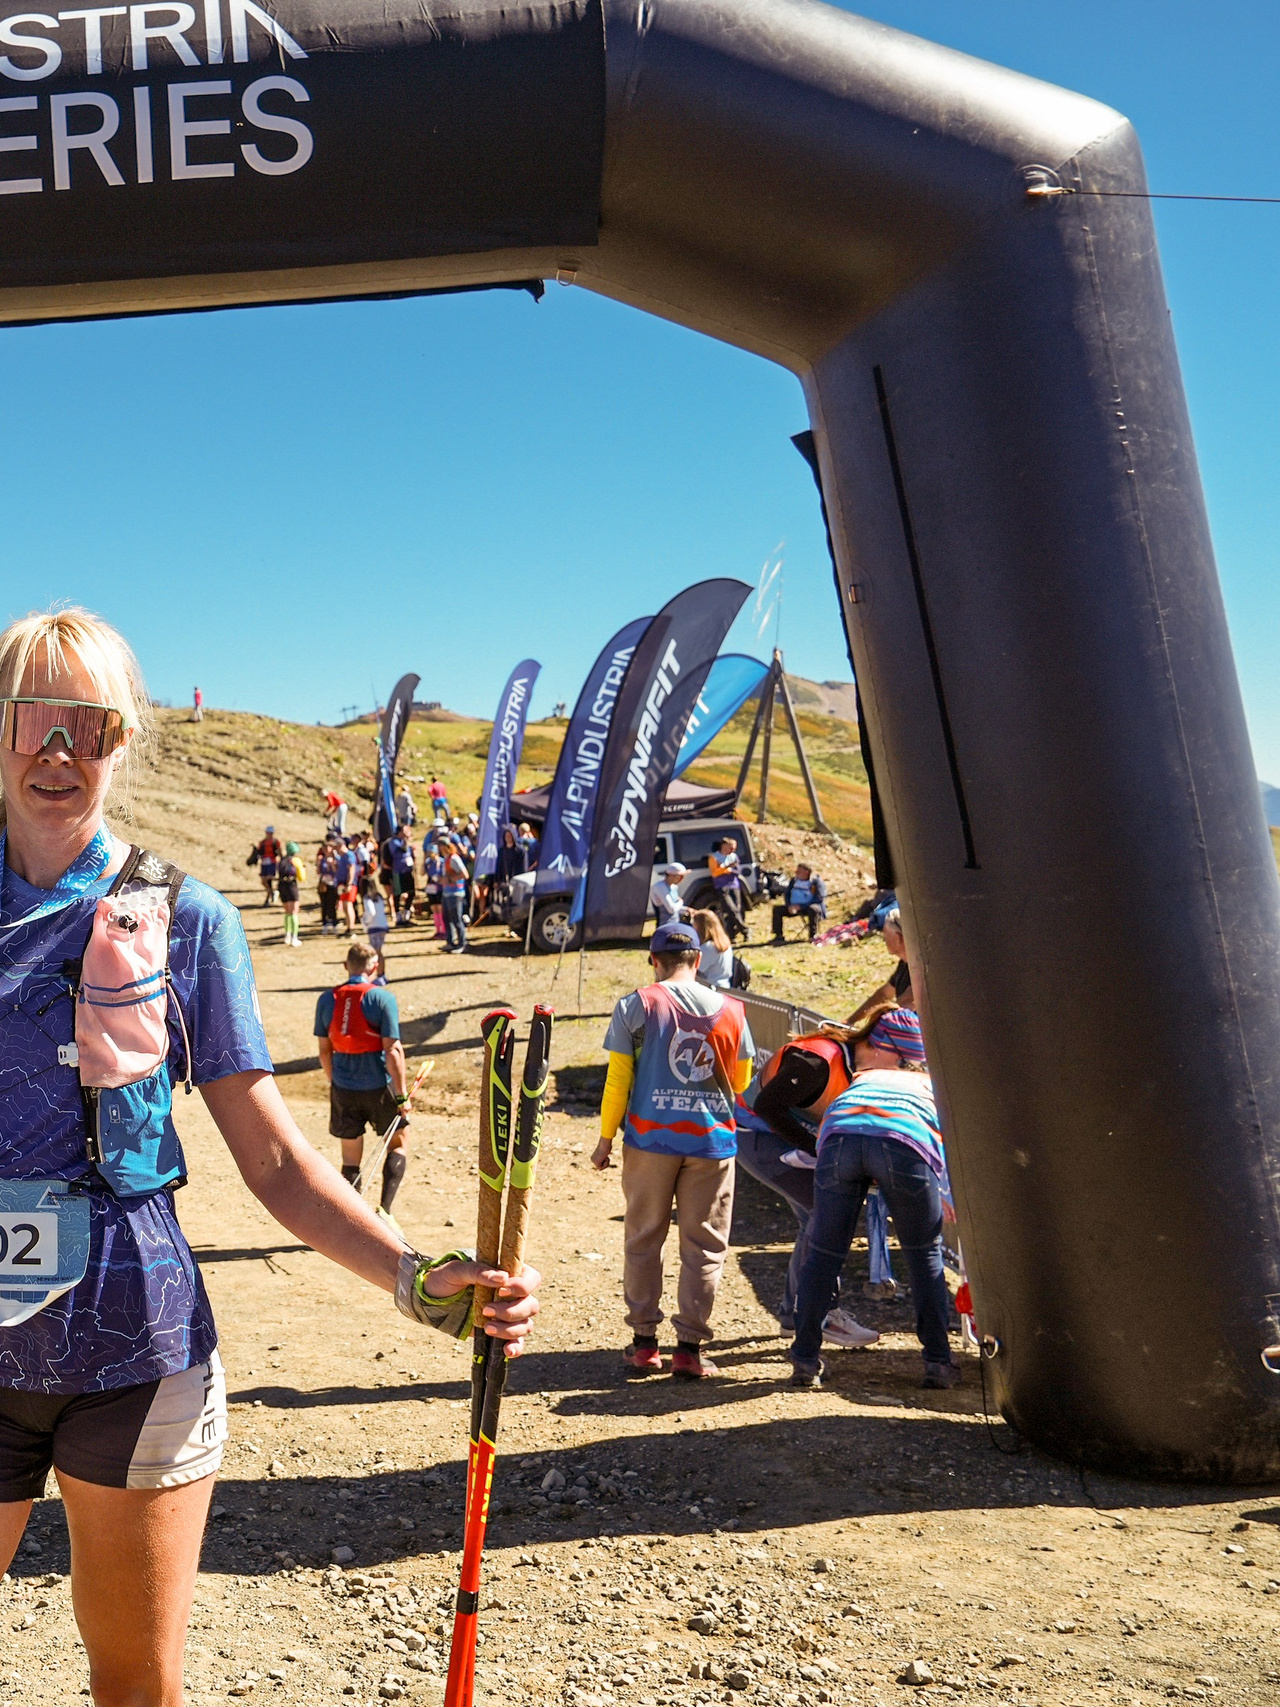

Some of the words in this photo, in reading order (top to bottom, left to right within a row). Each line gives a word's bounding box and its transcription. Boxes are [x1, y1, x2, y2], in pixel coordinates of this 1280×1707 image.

[487, 677, 529, 829] ALPINDUSTRIA
[560, 645, 636, 842] ALPINDUSTRIA
[618, 638, 681, 845] DYNAFIT
[496, 1104, 508, 1152] LEKI
[651, 1095, 730, 1114] TEAM
